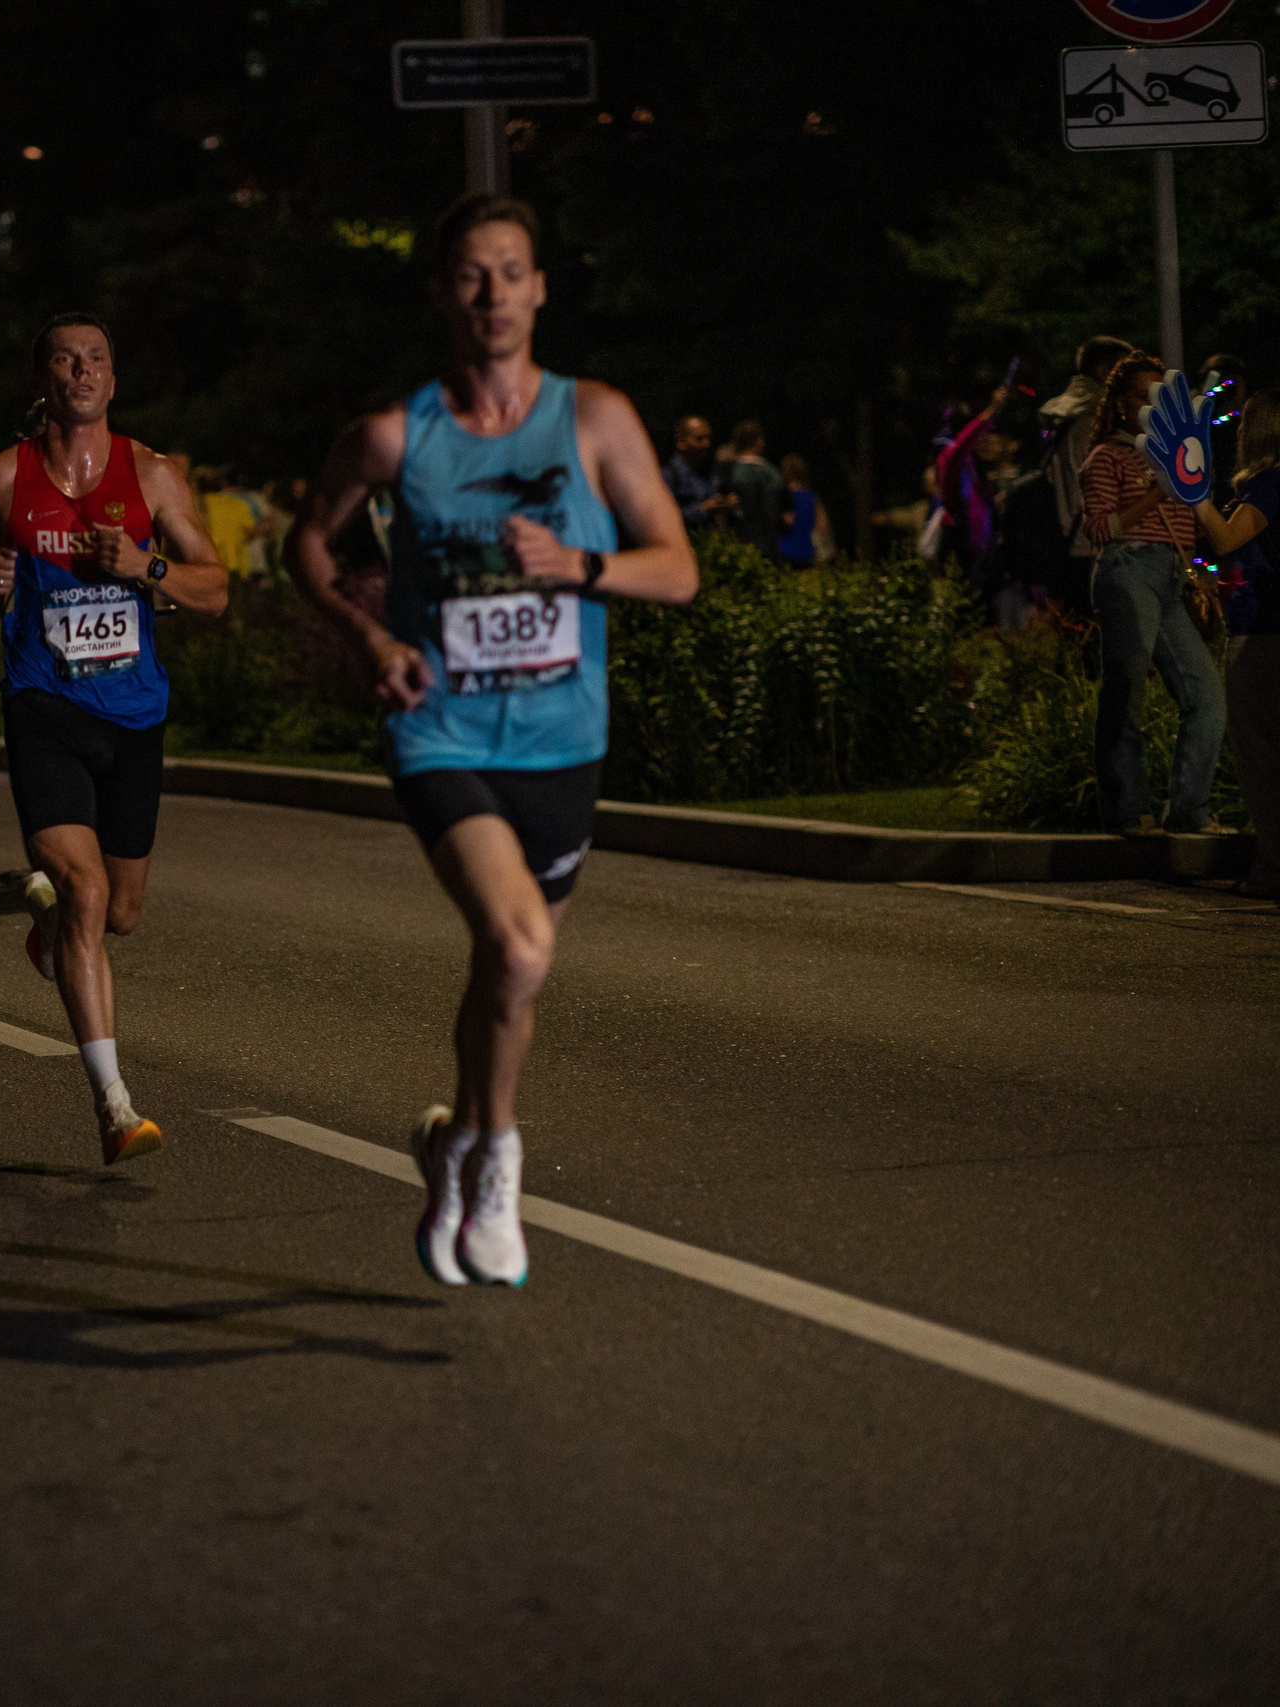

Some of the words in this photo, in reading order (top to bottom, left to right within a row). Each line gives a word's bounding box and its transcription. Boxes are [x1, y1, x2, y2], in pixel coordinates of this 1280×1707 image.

[37, 529, 100, 554] RUSS
[60, 610, 127, 643] 1465
[466, 604, 560, 645] 1389
[64, 641, 122, 655] КОНСТАНТИН
